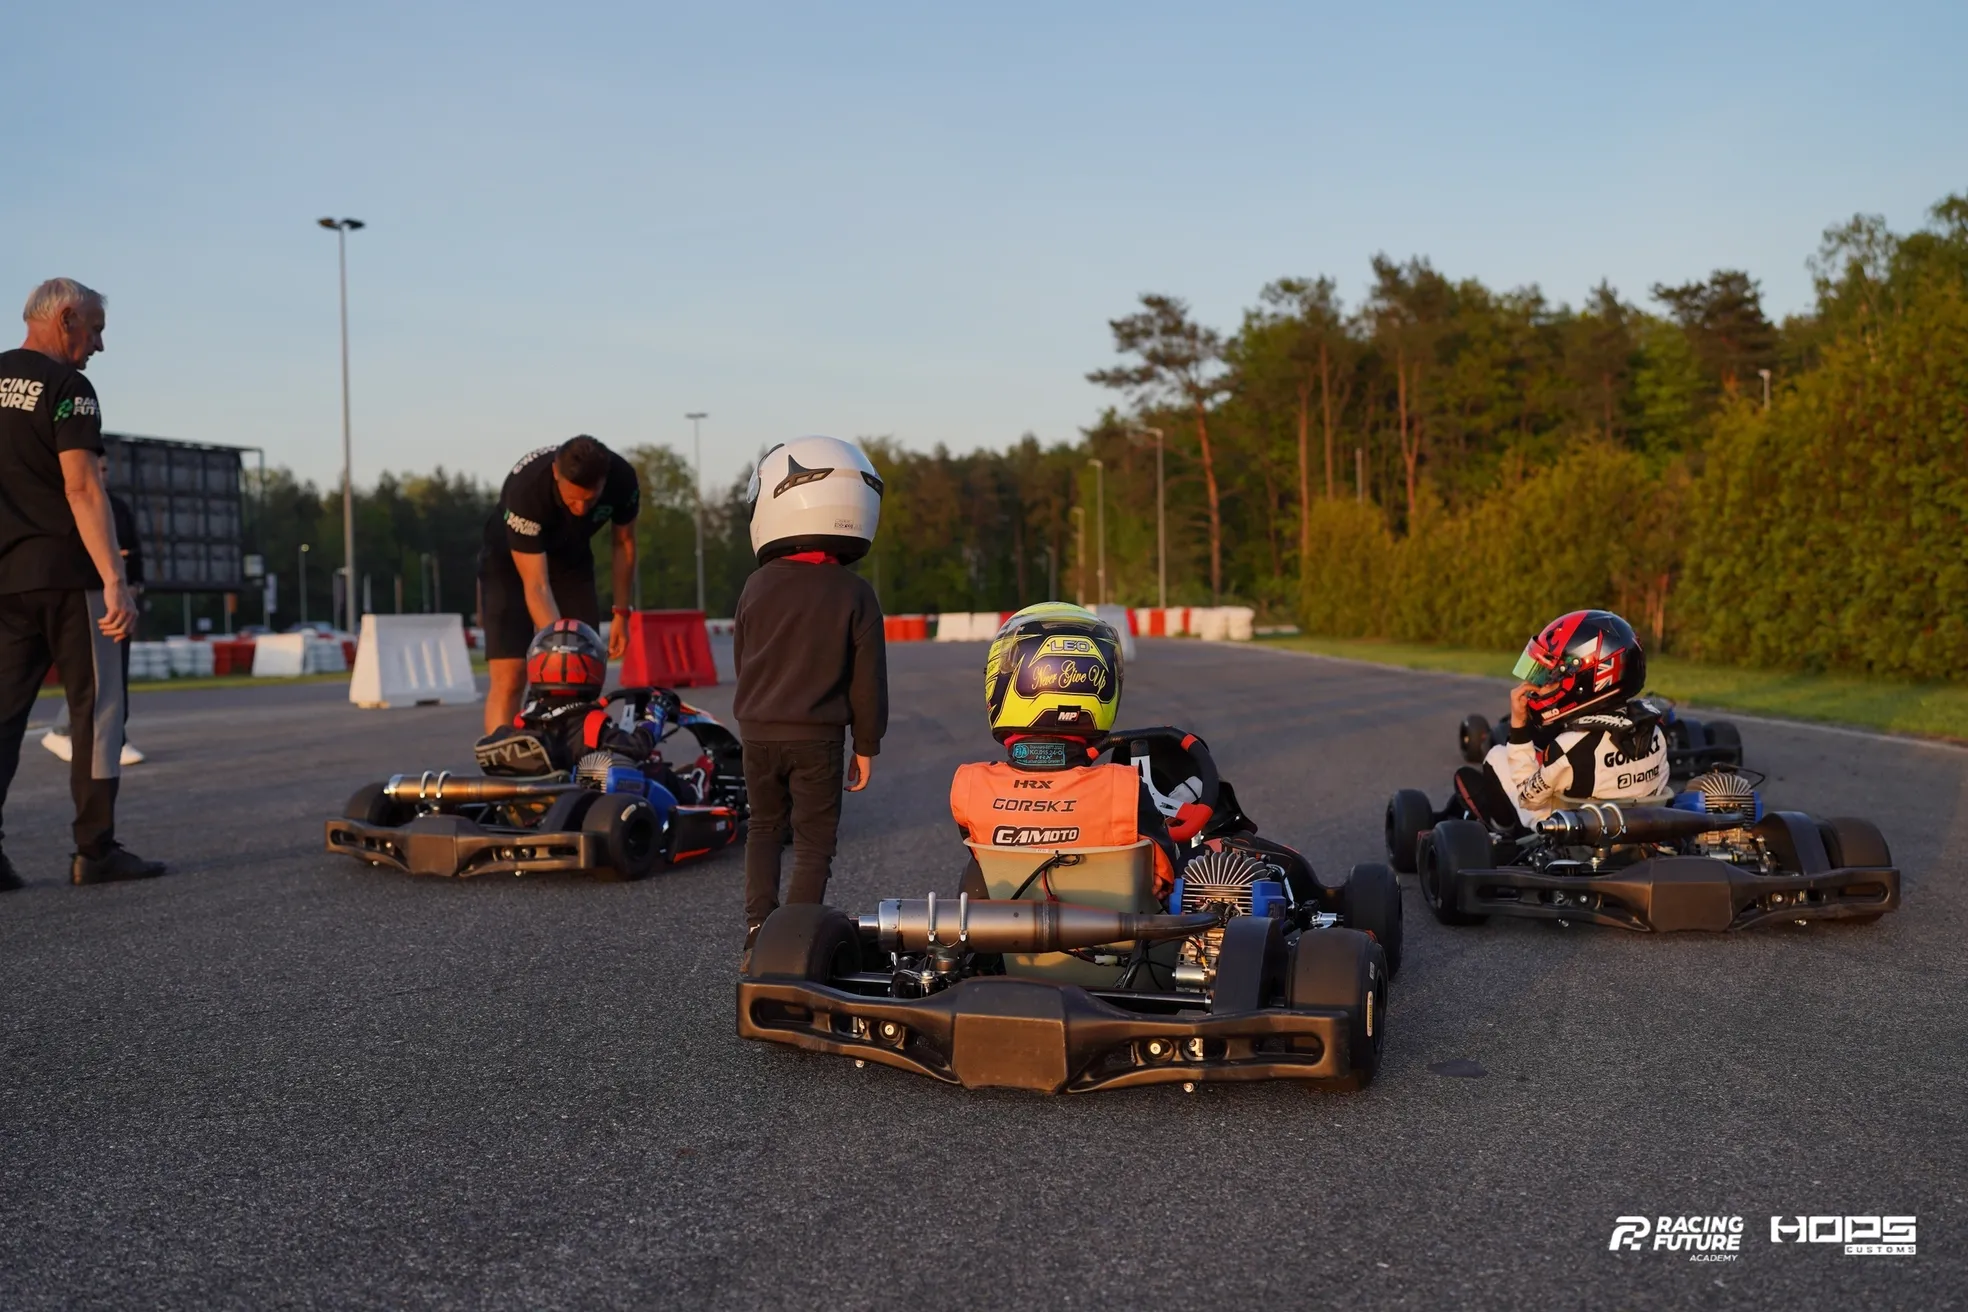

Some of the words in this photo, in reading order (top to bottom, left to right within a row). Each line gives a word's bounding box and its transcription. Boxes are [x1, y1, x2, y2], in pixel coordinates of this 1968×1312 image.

[0, 378, 44, 396] CING
[1051, 640, 1090, 651] LEO
[1032, 665, 1057, 689] Never
[1058, 660, 1087, 688] Give
[1088, 665, 1107, 694] Up
[1604, 735, 1660, 768] GOI
[1014, 780, 1054, 789] HRX
[993, 798, 1077, 812] GORSKI
[995, 829, 1078, 844] GAMOTO
